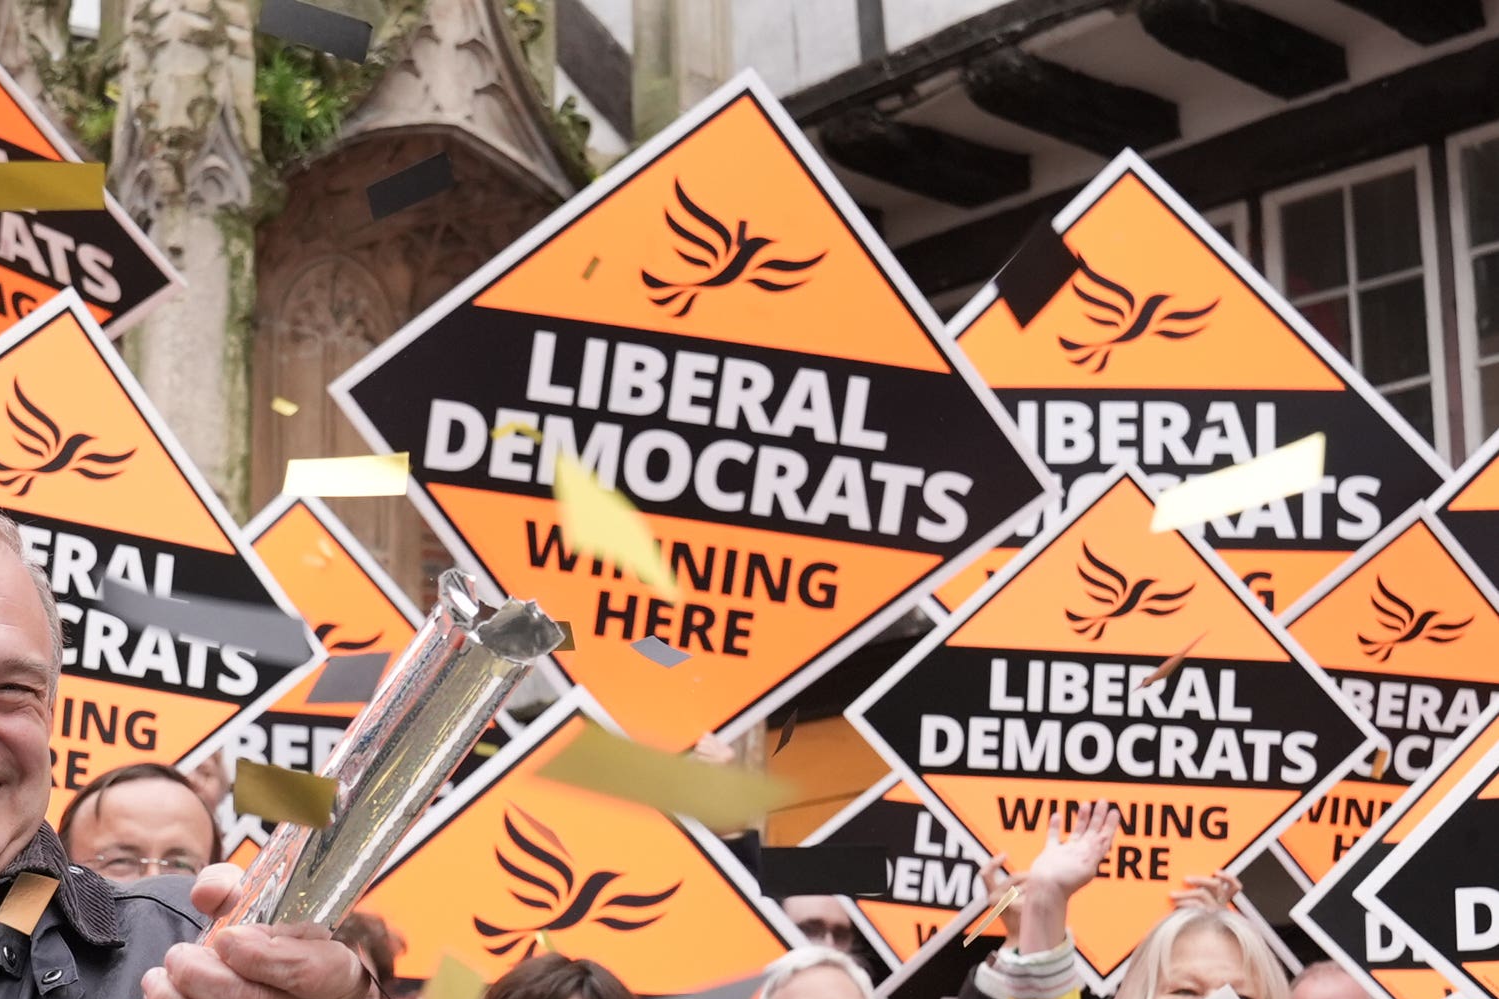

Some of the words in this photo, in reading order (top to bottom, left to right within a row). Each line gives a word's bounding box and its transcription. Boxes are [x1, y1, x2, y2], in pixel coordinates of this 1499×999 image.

[526, 330, 887, 452] LIBERAL
[423, 398, 973, 543] DEMOCRATS
[1017, 400, 1277, 466] IBERAL
[17, 525, 190, 604] ERAL
[525, 520, 839, 609] WNING
[54, 602, 258, 697] CRATS
[594, 591, 754, 658] HERE
[989, 658, 1252, 722] LIBERAL
[919, 714, 1318, 784] DEMOCRATS
